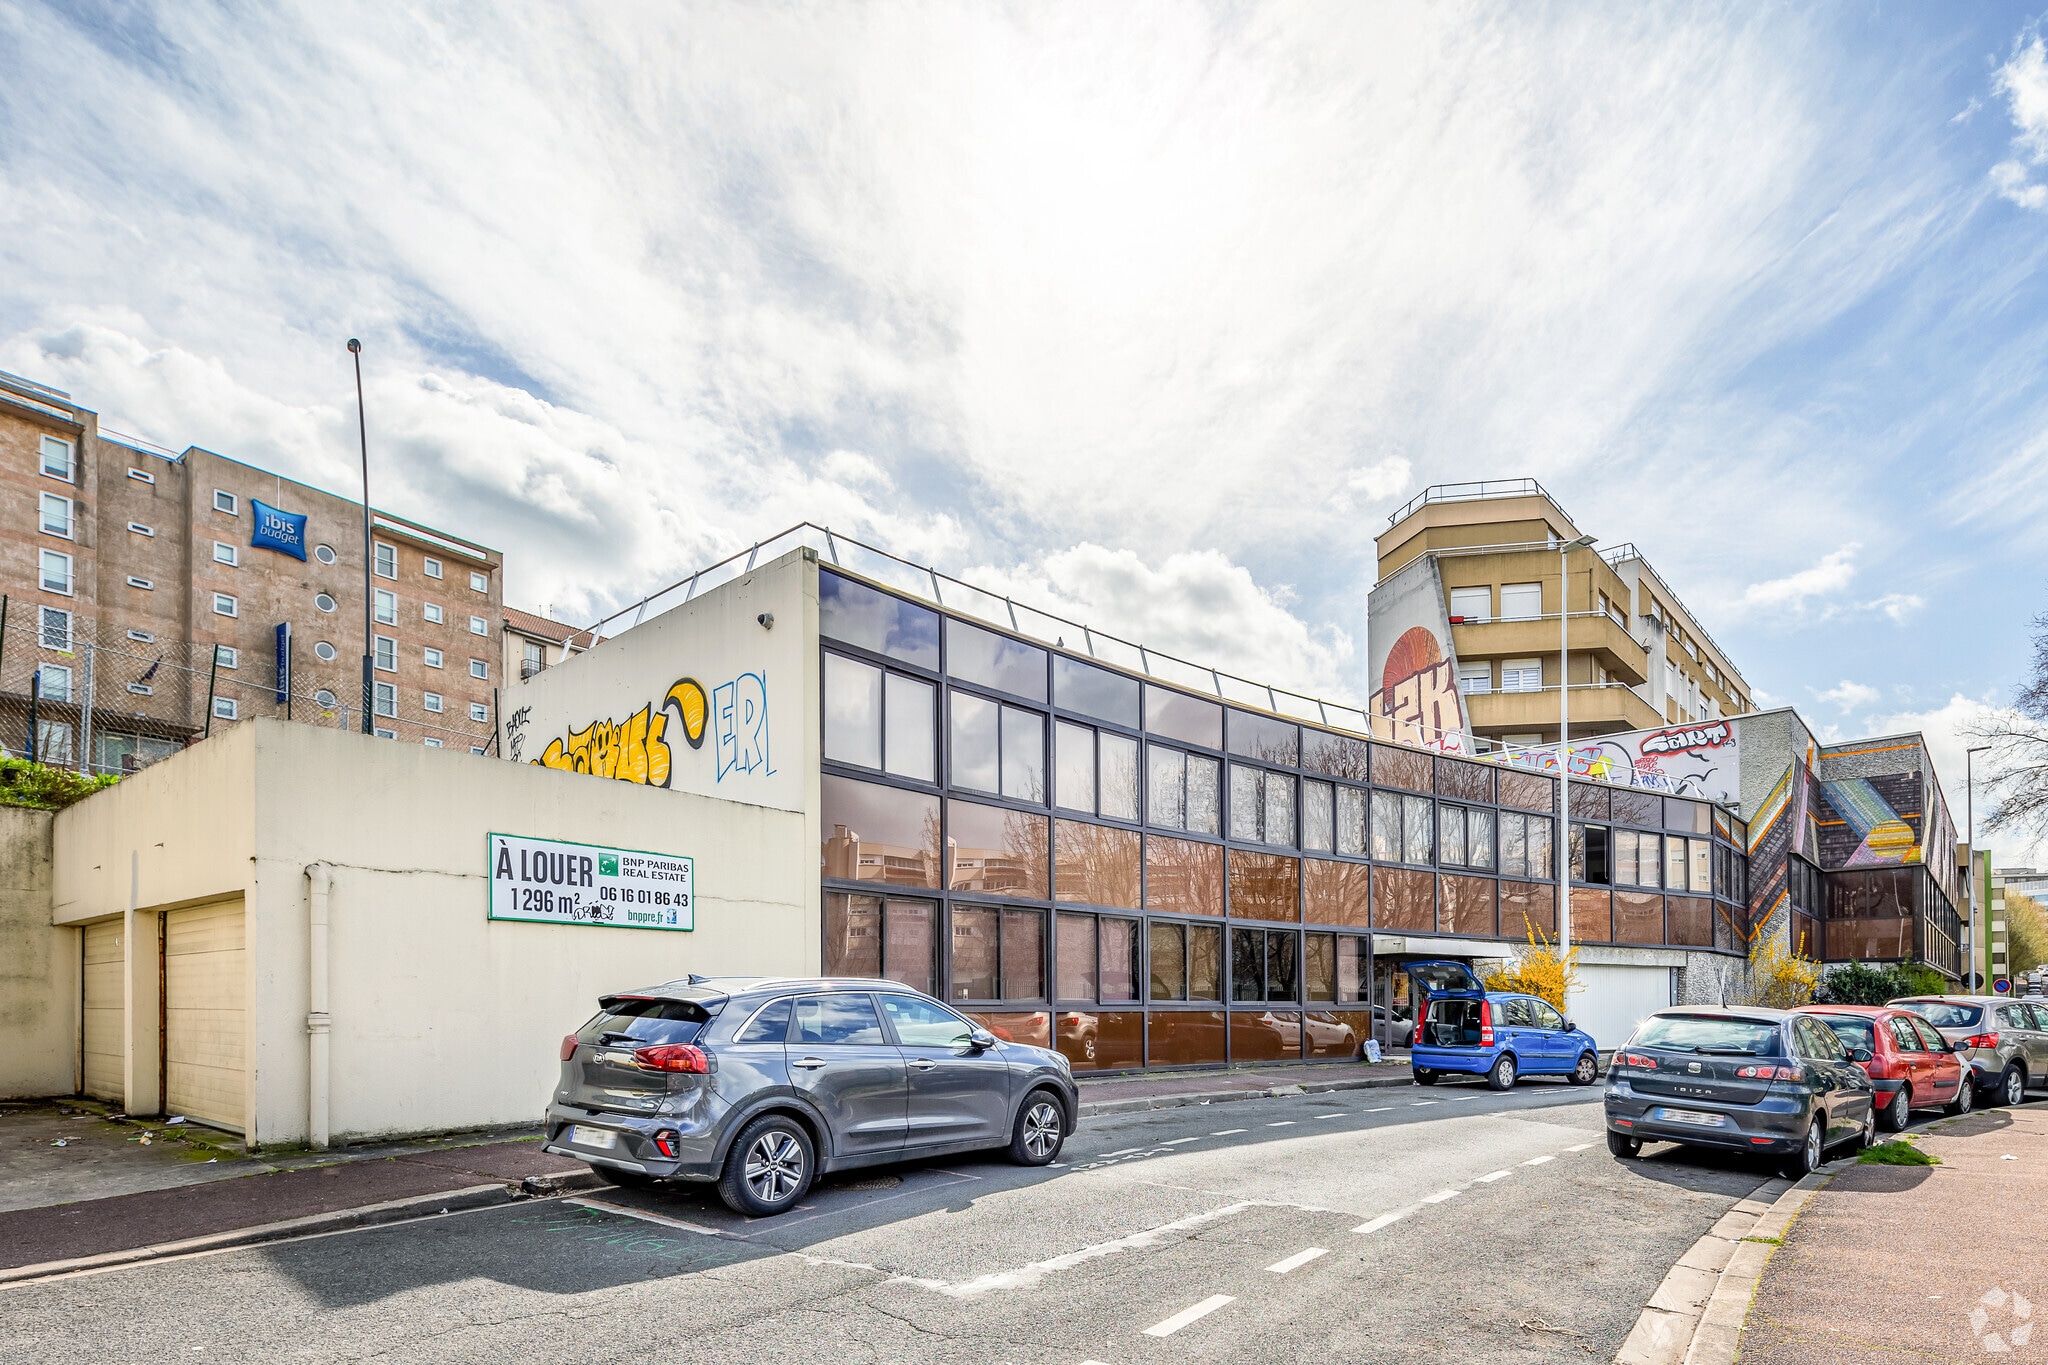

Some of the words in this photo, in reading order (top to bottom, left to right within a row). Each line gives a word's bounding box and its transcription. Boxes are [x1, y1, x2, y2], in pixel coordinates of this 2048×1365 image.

[265, 512, 295, 534] ibis
[260, 524, 300, 545] budget
[496, 838, 514, 880] À
[521, 849, 593, 888] LOUER
[622, 857, 645, 868] BNP
[647, 860, 689, 873] PARIBAS
[622, 868, 649, 879] REAL
[651, 871, 686, 882] ESTATE
[522, 888, 554, 913] 296
[558, 892, 580, 914] m²
[600, 886, 617, 901] 06
[620, 888, 634, 903] 16
[638, 889, 651, 904] 01
[654, 891, 671, 906] 86
[673, 893, 689, 907] 43
[627, 909, 664, 924] bnppre.fr
[1673, 1086, 1712, 1095] IBIZA
